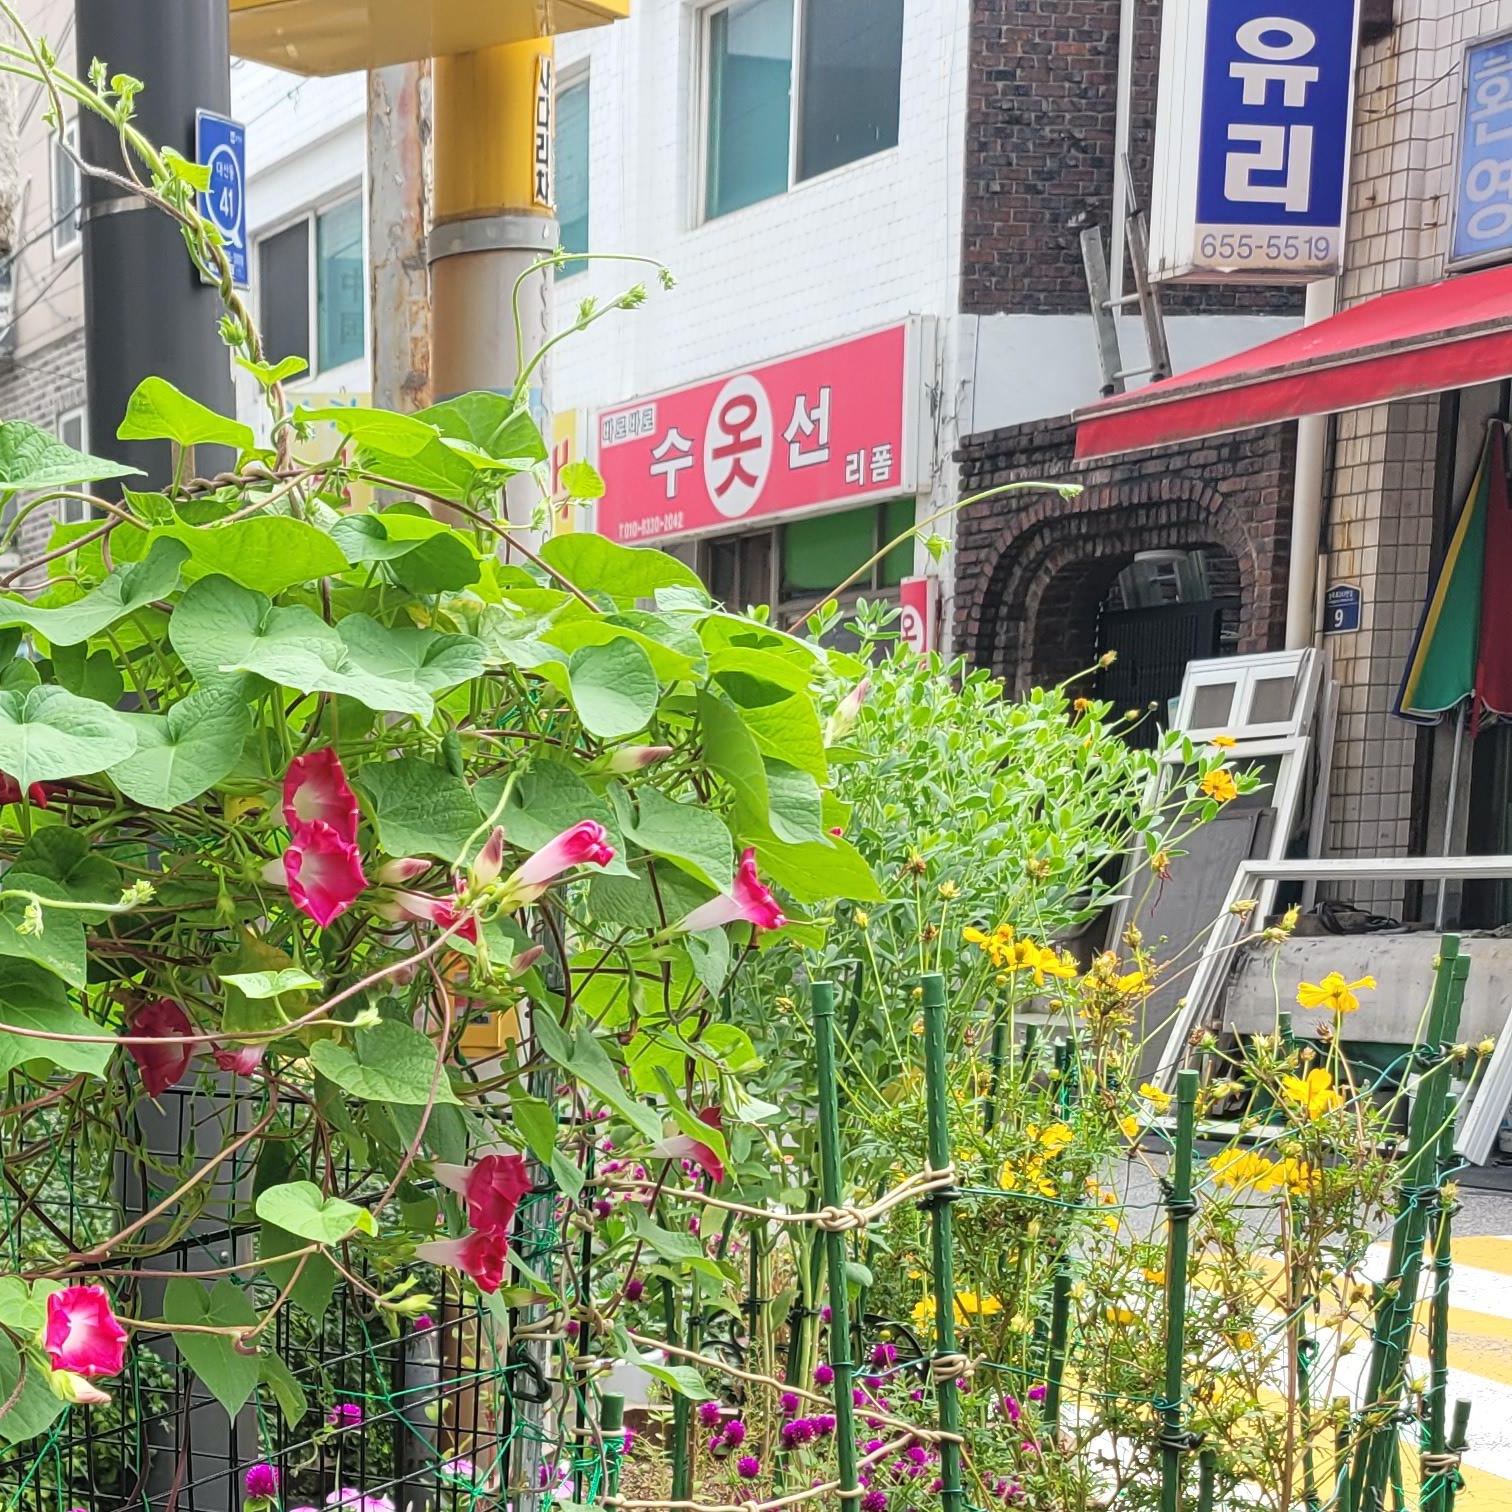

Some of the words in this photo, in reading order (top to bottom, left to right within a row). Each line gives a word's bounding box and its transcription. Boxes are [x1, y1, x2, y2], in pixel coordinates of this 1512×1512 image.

[1224, 17, 1319, 212] 유리
[220, 186, 234, 218] 41
[1201, 233, 1330, 261] 655-5519
[602, 407, 653, 443] 바로바로
[845, 444, 893, 487] 리폼
[1334, 608, 1344, 628] 9
